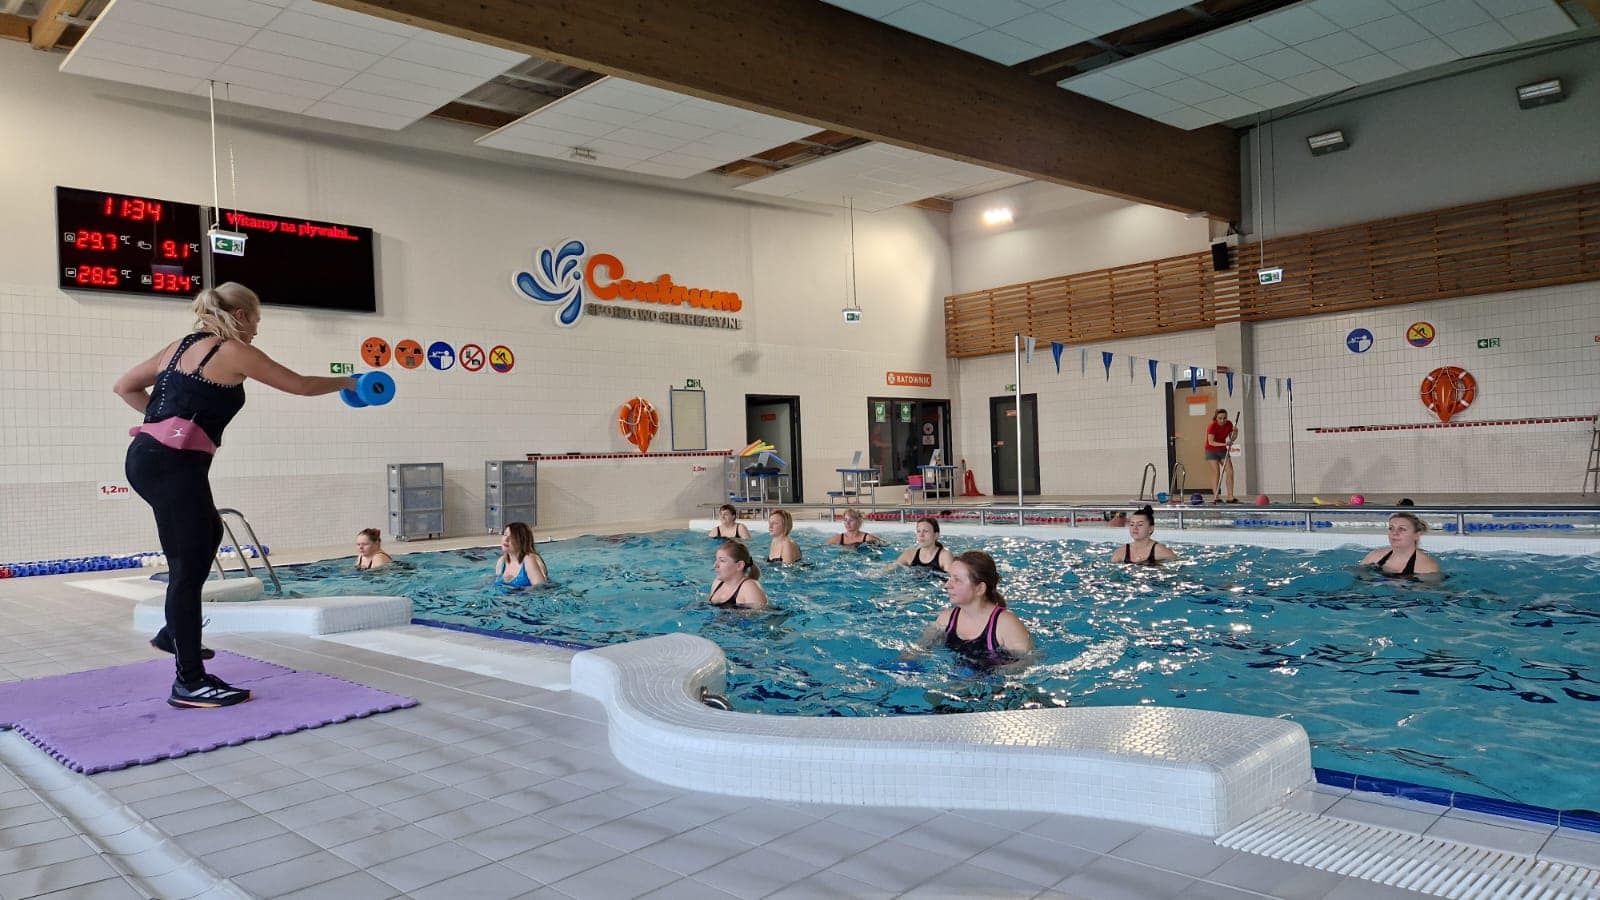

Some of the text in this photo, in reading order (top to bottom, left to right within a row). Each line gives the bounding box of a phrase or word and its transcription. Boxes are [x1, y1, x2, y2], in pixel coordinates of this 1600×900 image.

[104, 196, 161, 221] 11:34
[226, 212, 277, 231] Witamy
[280, 222, 296, 231] na
[76, 230, 118, 250] 29.7
[162, 240, 189, 258] 9.1
[78, 265, 118, 285] 28.5
[153, 272, 190, 291] 33.4
[586, 253, 742, 311] Centrum
[896, 375, 930, 385] RATOWNIK
[101, 485, 128, 495] 1,2m
